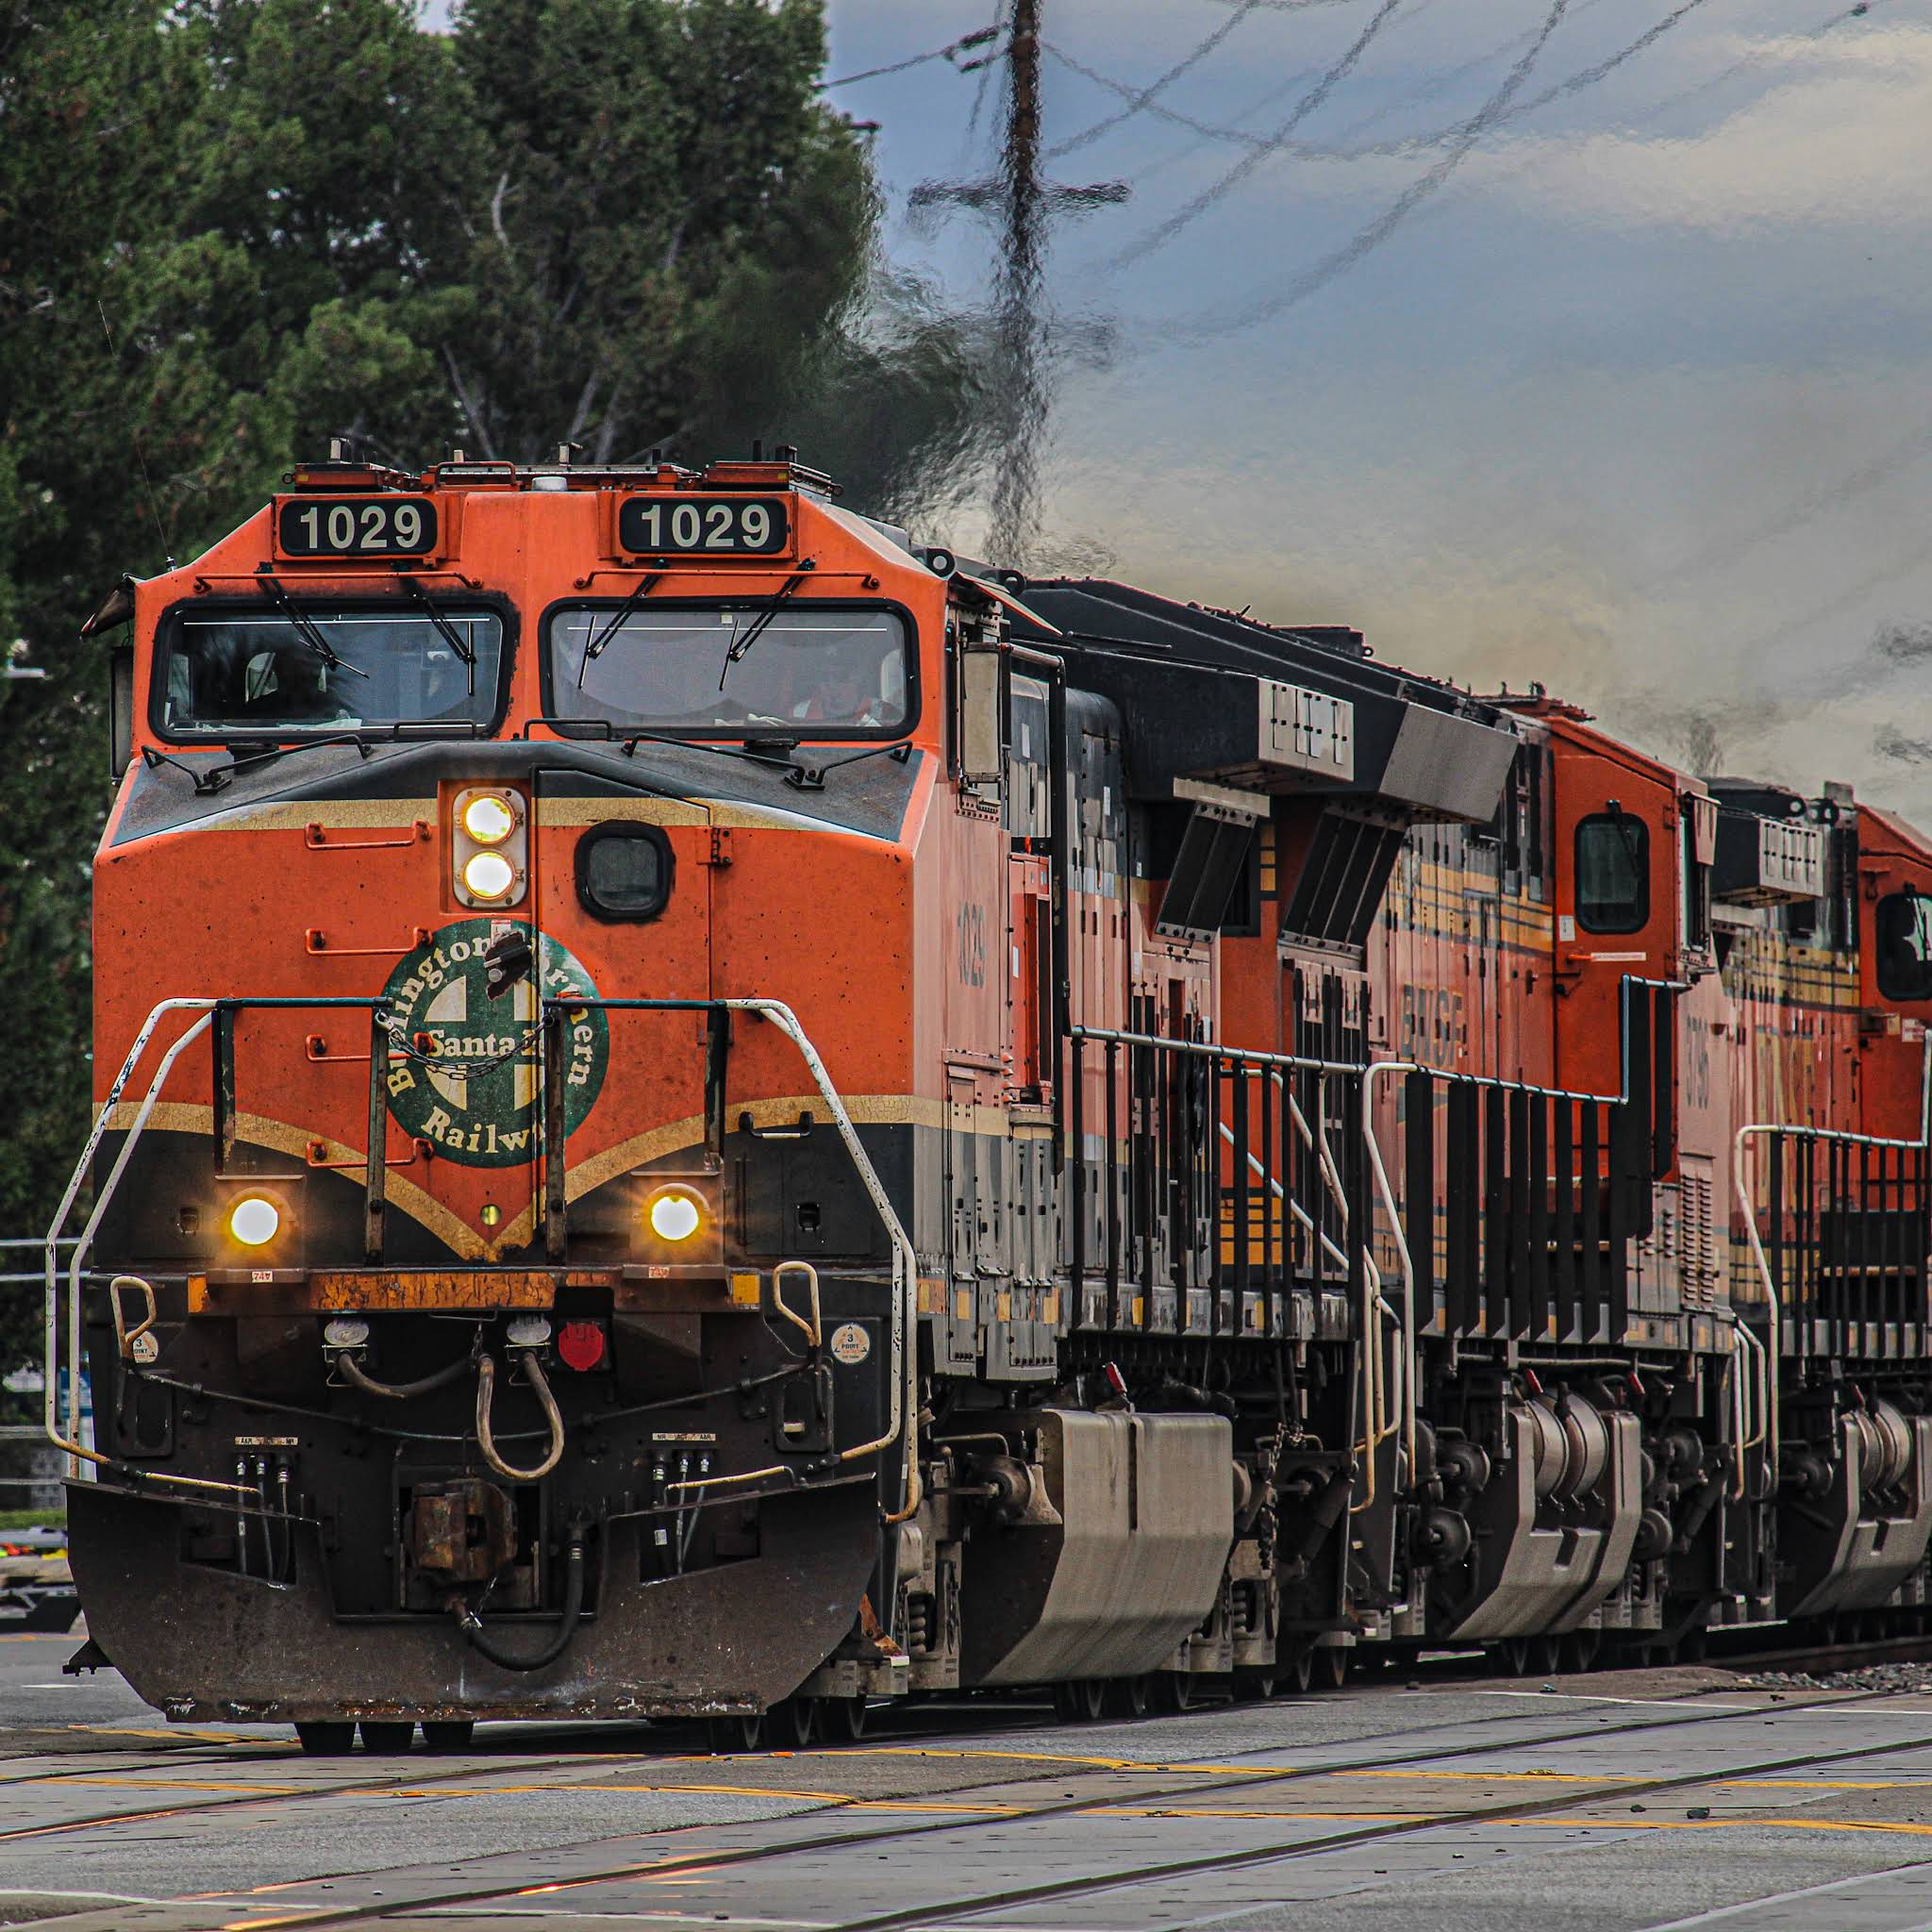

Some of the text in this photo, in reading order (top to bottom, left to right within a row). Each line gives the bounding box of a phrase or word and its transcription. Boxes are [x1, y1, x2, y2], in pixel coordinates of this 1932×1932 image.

[299, 505, 422, 549] 1029
[641, 504, 771, 548] 1029
[426, 1028, 516, 1058] Santa
[421, 1106, 544, 1154] Railw
[137, 1339, 142, 1347] 3
[847, 1334, 854, 1342] 3
